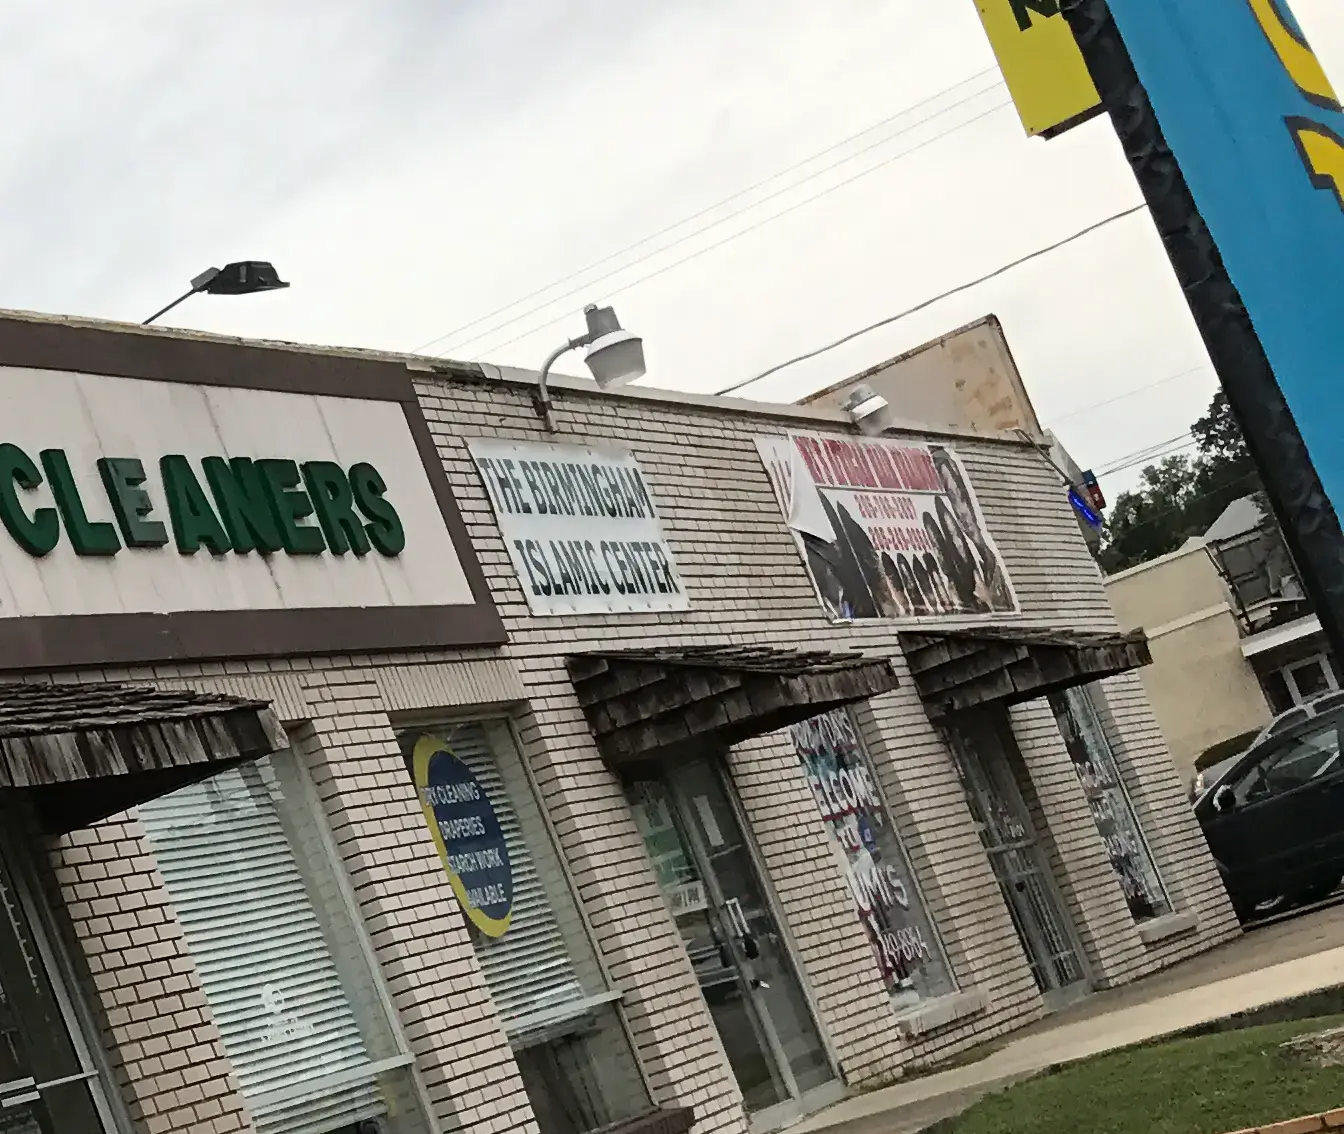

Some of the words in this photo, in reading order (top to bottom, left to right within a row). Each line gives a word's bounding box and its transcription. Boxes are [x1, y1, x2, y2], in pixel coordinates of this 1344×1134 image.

[476, 457, 532, 514] THE
[519, 460, 656, 518] BIRMINGHAM
[514, 539, 611, 597] ISLAMIC
[601, 540, 681, 596] CENTER
[438, 781, 481, 804] CLEANING
[808, 767, 881, 817] ELCOME
[438, 815, 487, 841] DRAPERIES
[476, 847, 504, 869] WORK
[466, 883, 508, 908] AVAILABLE
